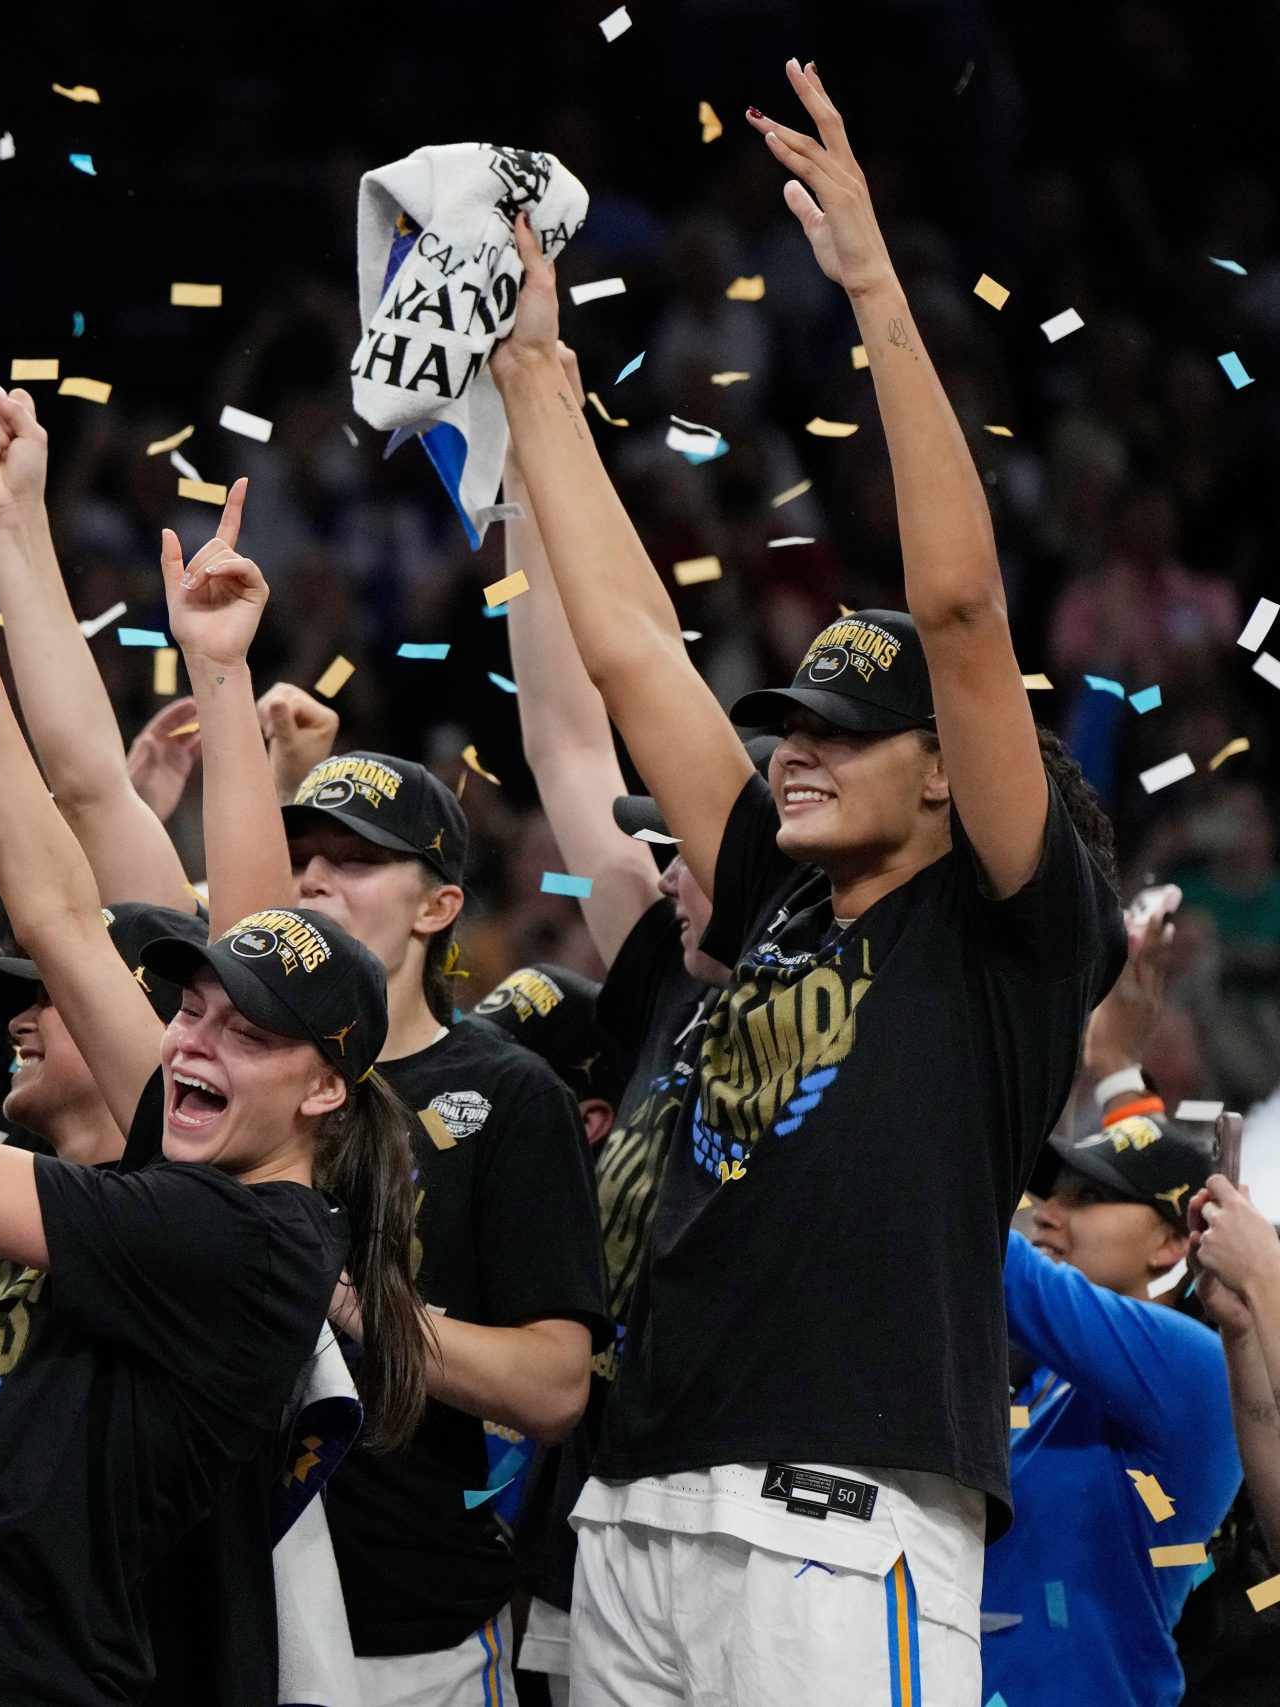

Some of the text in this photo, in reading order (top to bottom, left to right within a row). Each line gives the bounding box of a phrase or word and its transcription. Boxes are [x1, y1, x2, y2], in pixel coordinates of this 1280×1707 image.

[867, 623, 902, 651] NATIONAL
[304, 922, 333, 960] NATIONAL
[432, 1101, 489, 1123] FINAL FOUR
[838, 1488, 857, 1504] 50
